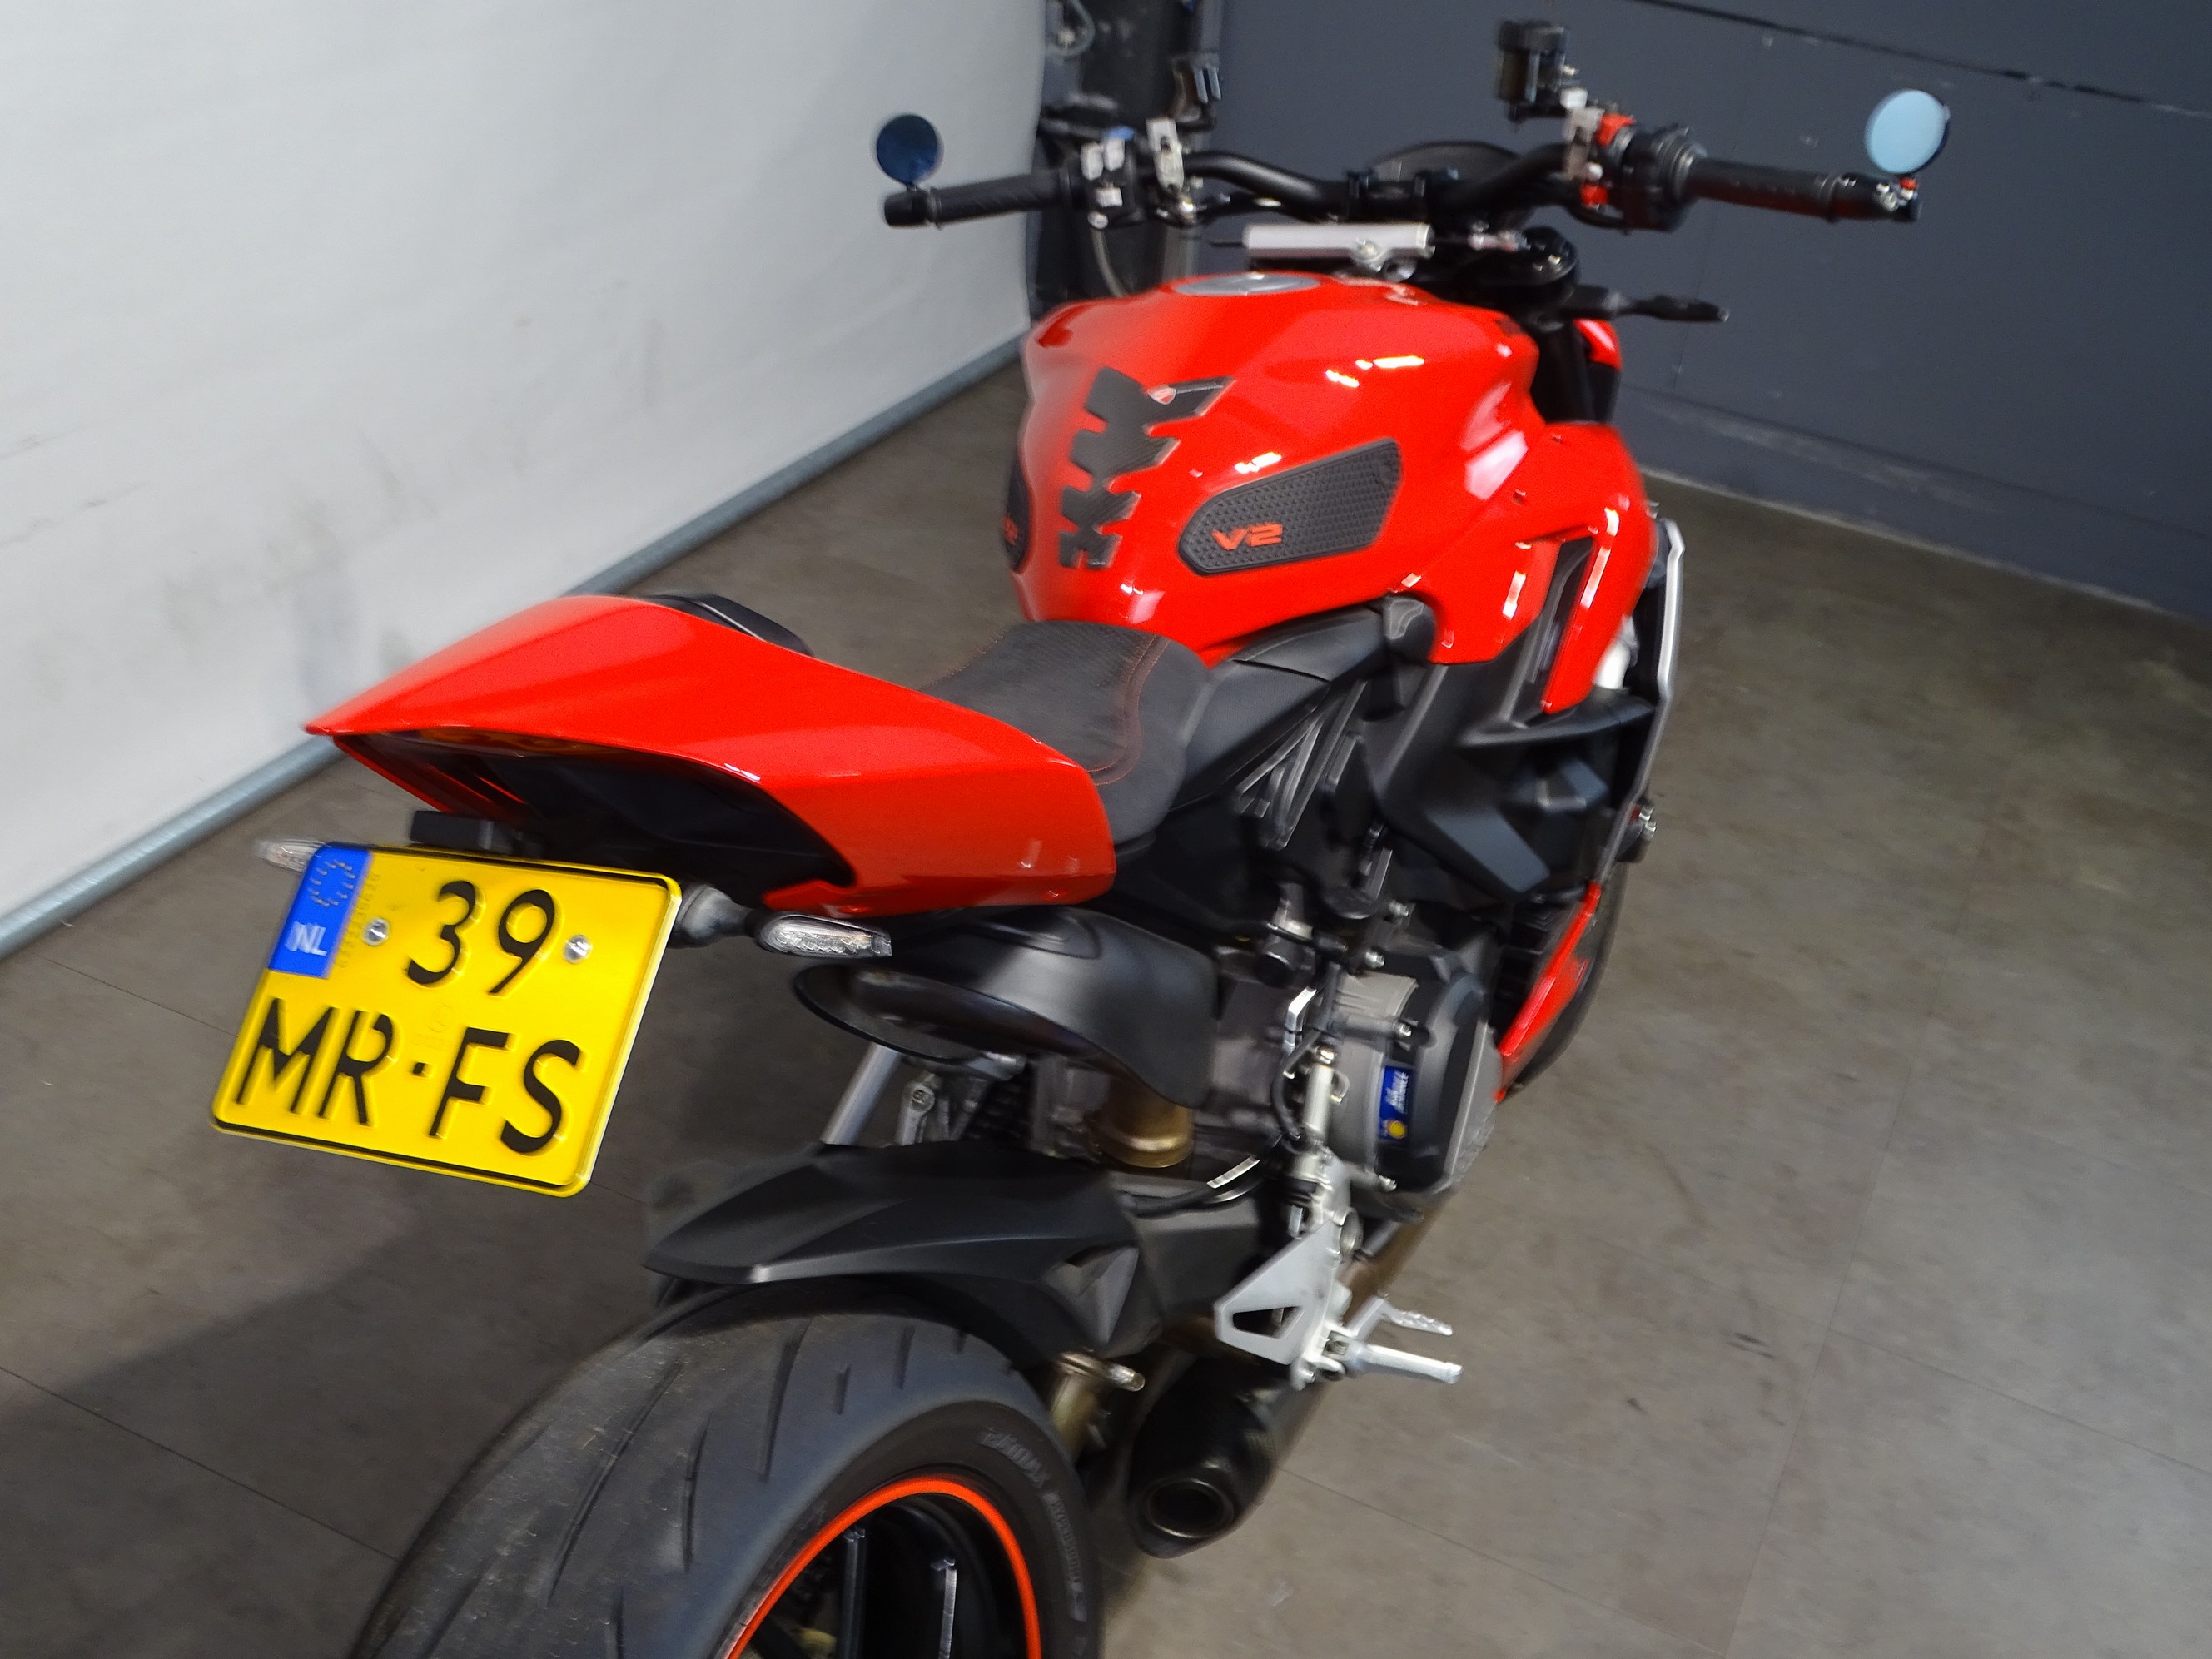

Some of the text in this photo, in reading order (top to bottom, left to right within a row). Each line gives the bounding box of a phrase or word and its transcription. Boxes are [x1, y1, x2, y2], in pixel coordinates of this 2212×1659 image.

[1211, 522, 1283, 550] V2
[286, 920, 328, 956] NL
[405, 880, 556, 995] 39
